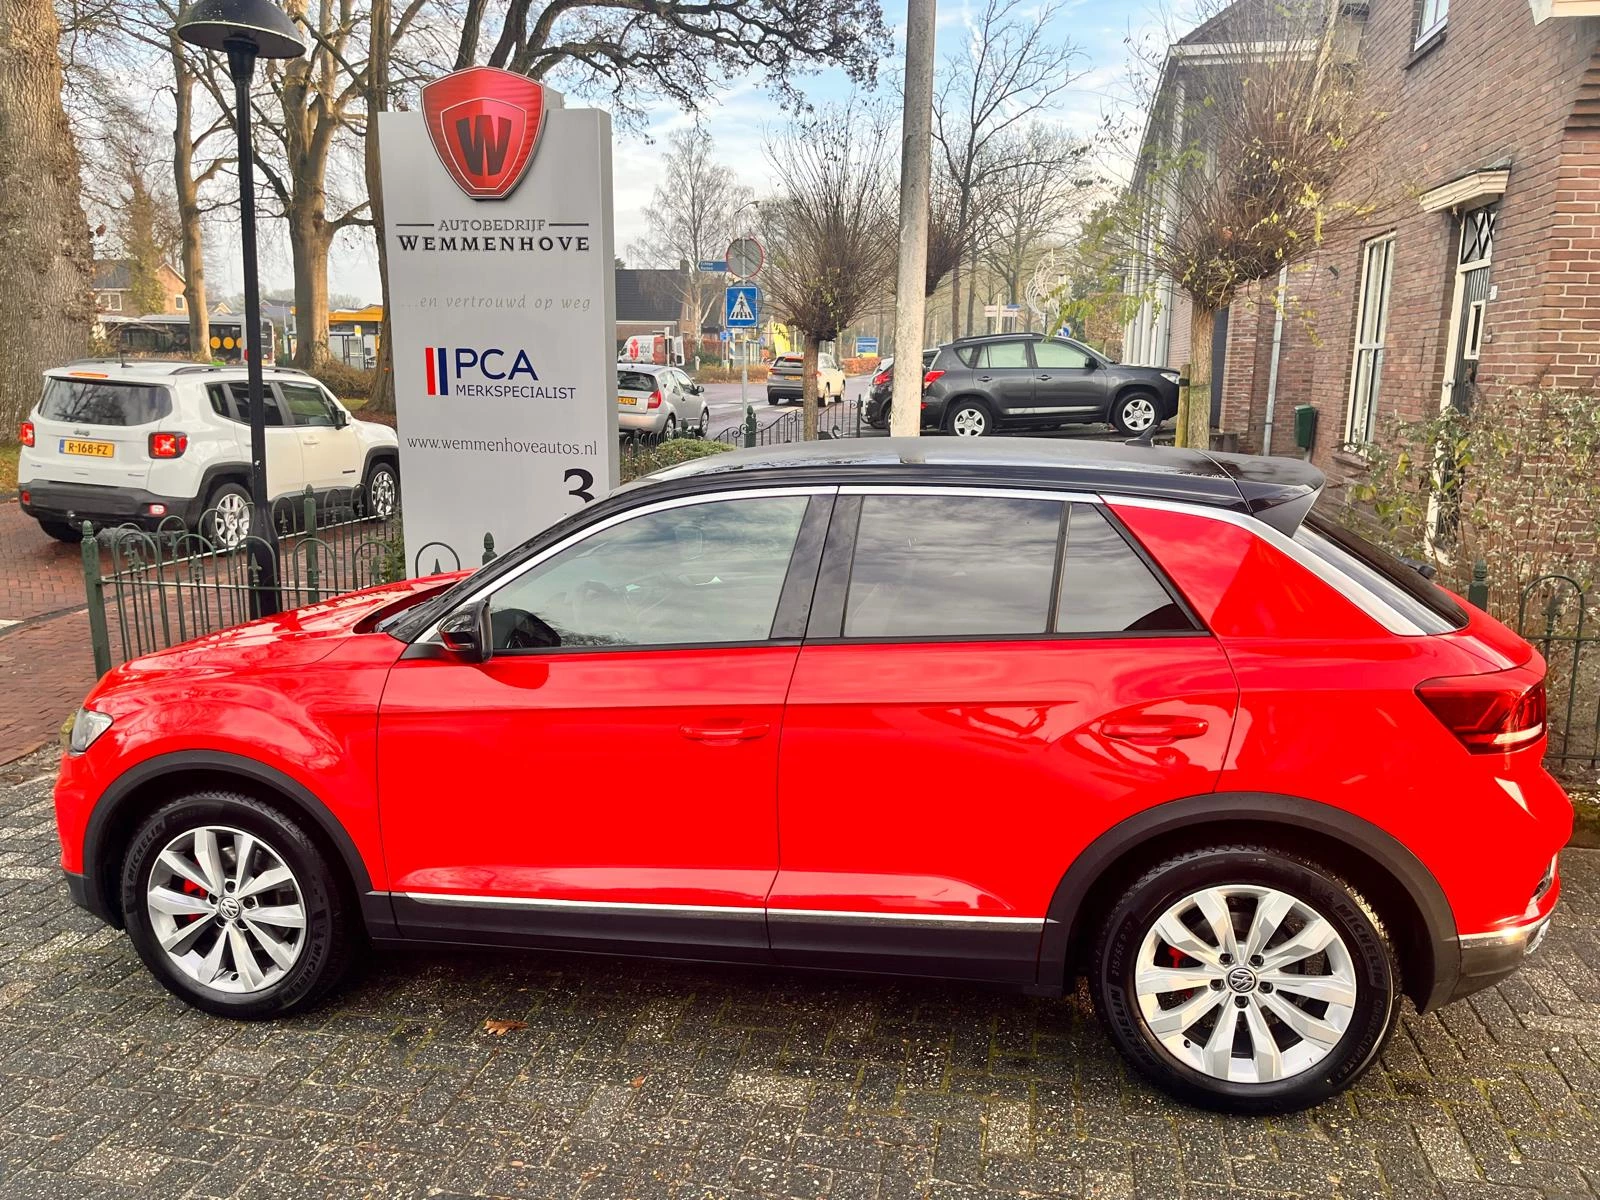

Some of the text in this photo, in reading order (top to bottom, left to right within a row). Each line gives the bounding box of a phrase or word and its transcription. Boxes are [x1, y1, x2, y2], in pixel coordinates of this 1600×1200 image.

[455, 114, 512, 177] W
[438, 219, 546, 231] AUTOBEDRIJF
[396, 235, 590, 251] WEMMENHOVE
[446, 294, 526, 309] vertrouwd
[534, 298, 553, 310] op
[561, 298, 592, 312] weg
[455, 348, 539, 381] PCA
[456, 384, 577, 399] MERKSPECIALIST
[68, 442, 108, 455] R-168-FZ
[407, 437, 598, 455] www.wemmenhoveautos.nl
[563, 468, 595, 503] 3
[127, 822, 162, 882] MICHELIN
[1335, 903, 1386, 984] MICHELIN
